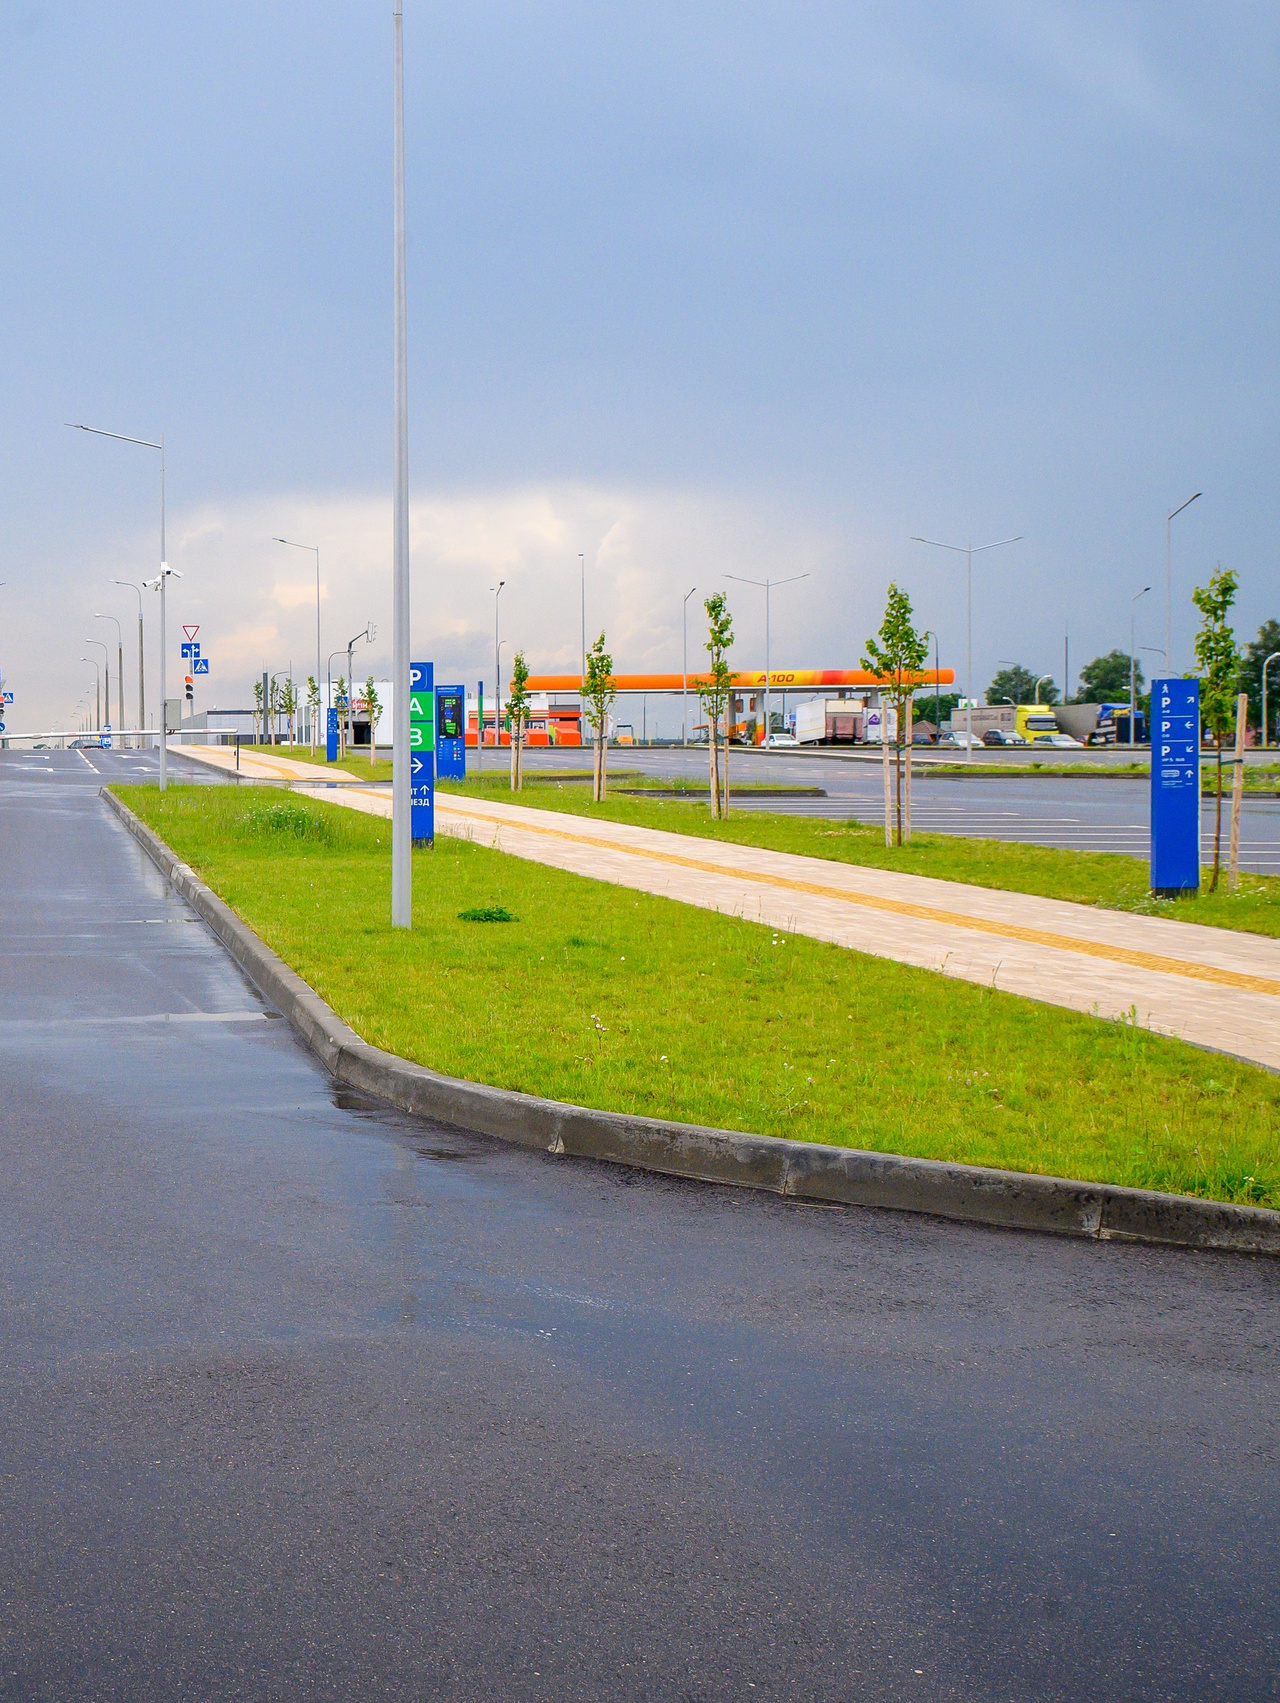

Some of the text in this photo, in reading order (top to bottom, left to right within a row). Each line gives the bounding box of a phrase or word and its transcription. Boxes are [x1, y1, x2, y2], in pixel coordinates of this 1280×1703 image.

[410, 669, 422, 686] P
[410, 697, 424, 715] A
[1162, 697, 1170, 708] P
[1162, 722, 1170, 732] P
[410, 728, 423, 746] B
[1162, 746, 1170, 756] P
[410, 798, 430, 807] ЕЗД
